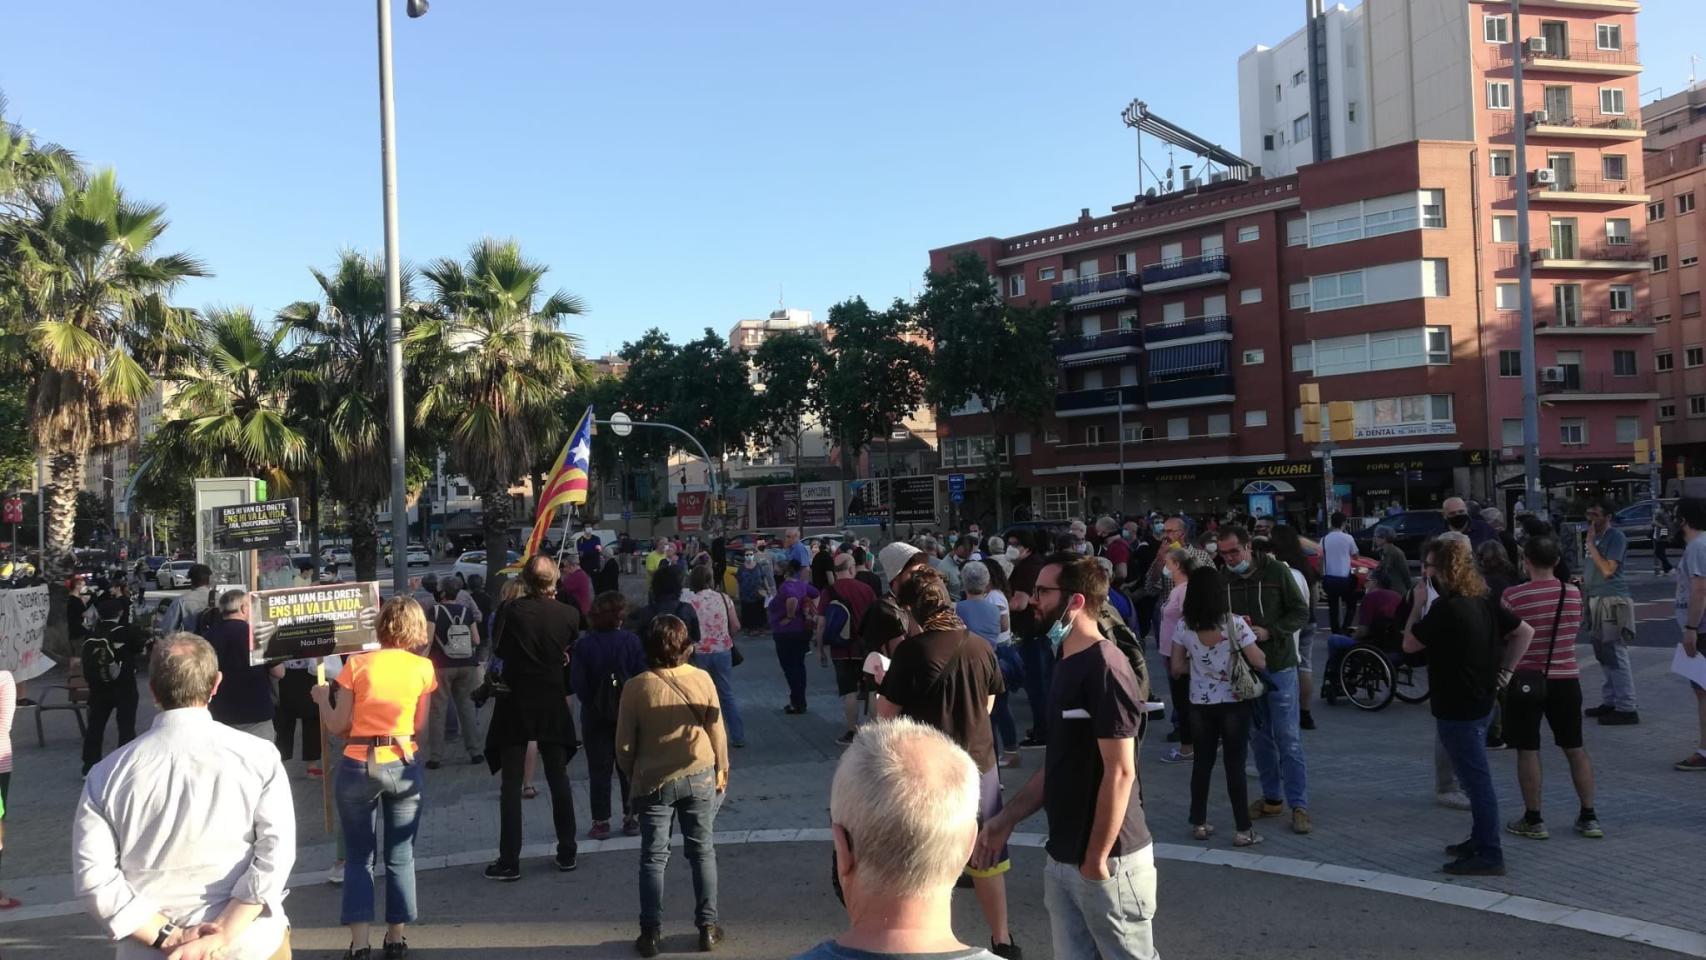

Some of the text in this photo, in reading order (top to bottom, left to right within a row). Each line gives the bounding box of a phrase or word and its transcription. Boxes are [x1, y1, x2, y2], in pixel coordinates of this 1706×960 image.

[1365, 428, 1395, 437] DENTAL
[1267, 464, 1312, 475] VIVARI
[1366, 462, 1390, 471] FORN
[223, 508, 235, 516] ENS
[242, 505, 254, 513] VAN
[255, 504, 265, 512] ELS
[223, 514, 238, 523] ENS
[239, 513, 247, 522] HI
[247, 512, 257, 521] VA
[257, 512, 268, 520] LA
[268, 588, 363, 606] ENS HI VAN ELS DRETS.
[269, 597, 363, 618] ENS HI VA LA VIDA.
[300, 637, 338, 647] Nou Barris
